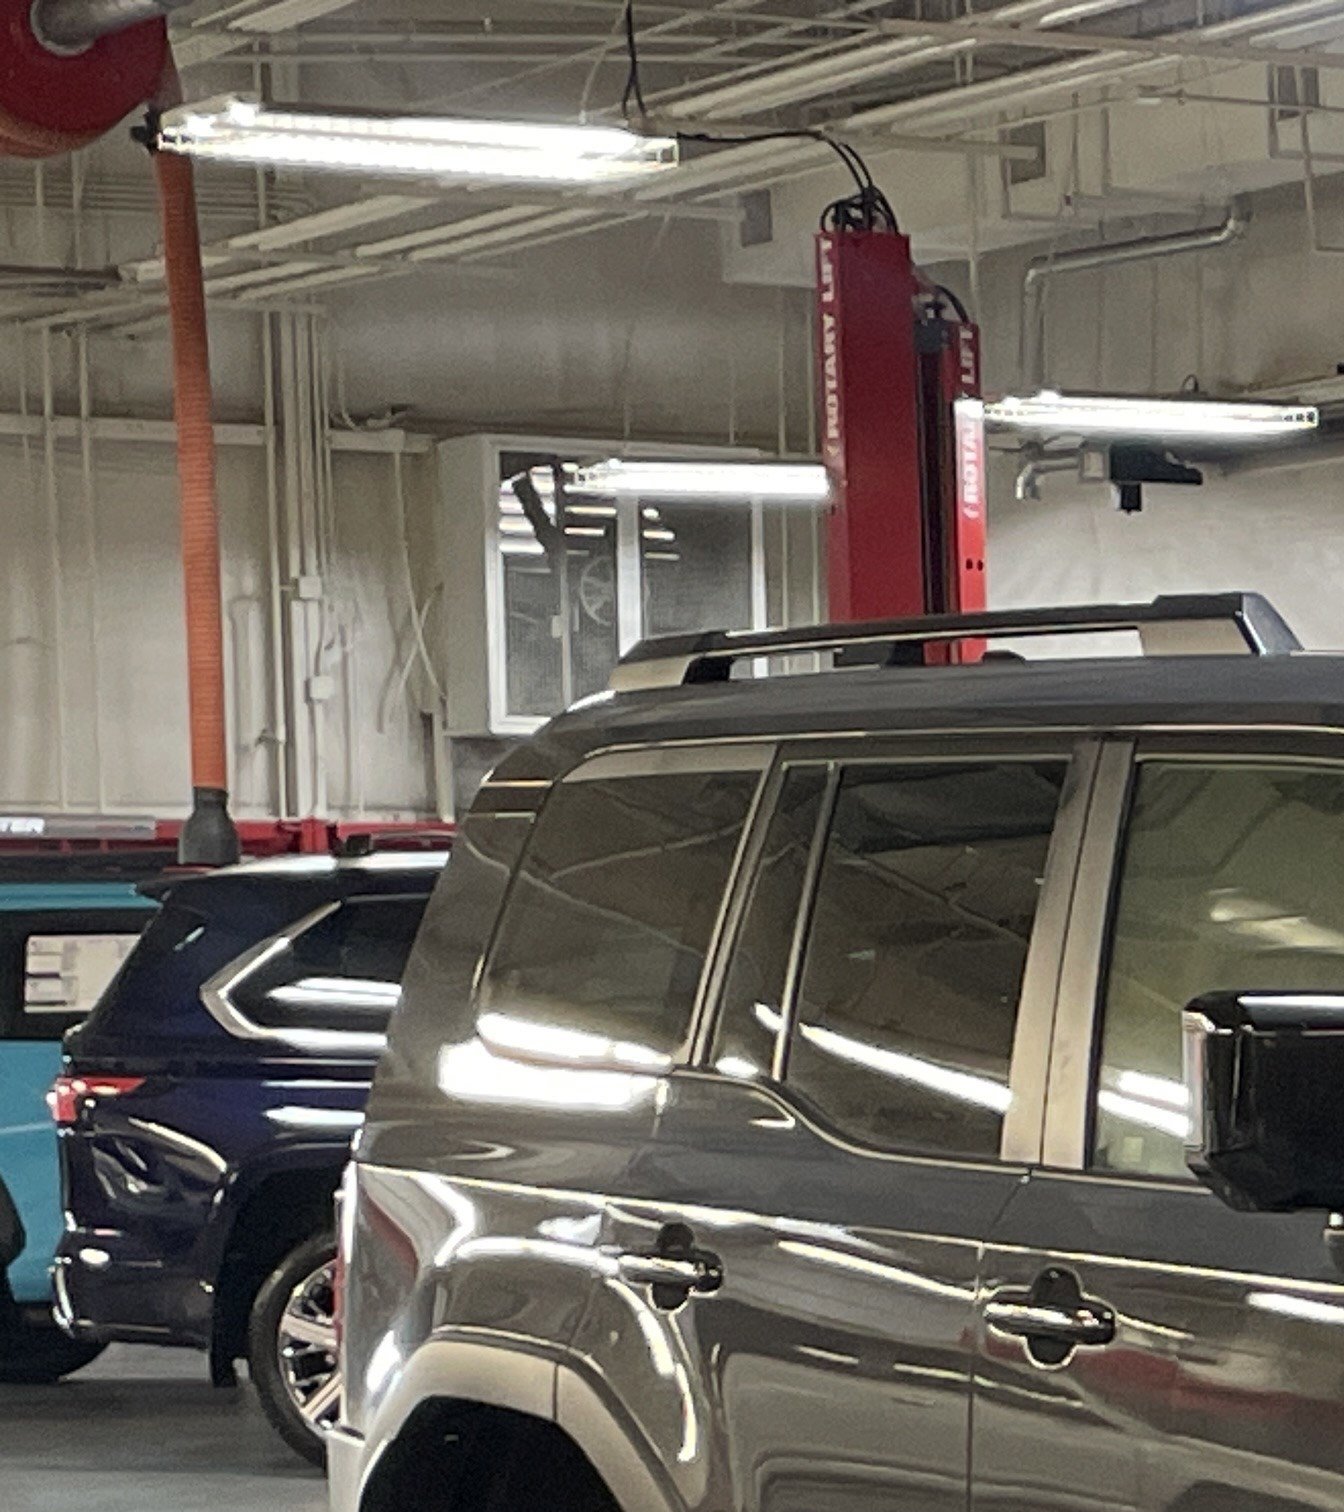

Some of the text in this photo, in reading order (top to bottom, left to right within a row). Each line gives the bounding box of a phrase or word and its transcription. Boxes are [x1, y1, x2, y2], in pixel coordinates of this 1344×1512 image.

[820, 237, 839, 438] ROTARY LIFT
[960, 325, 975, 384] LIFT
